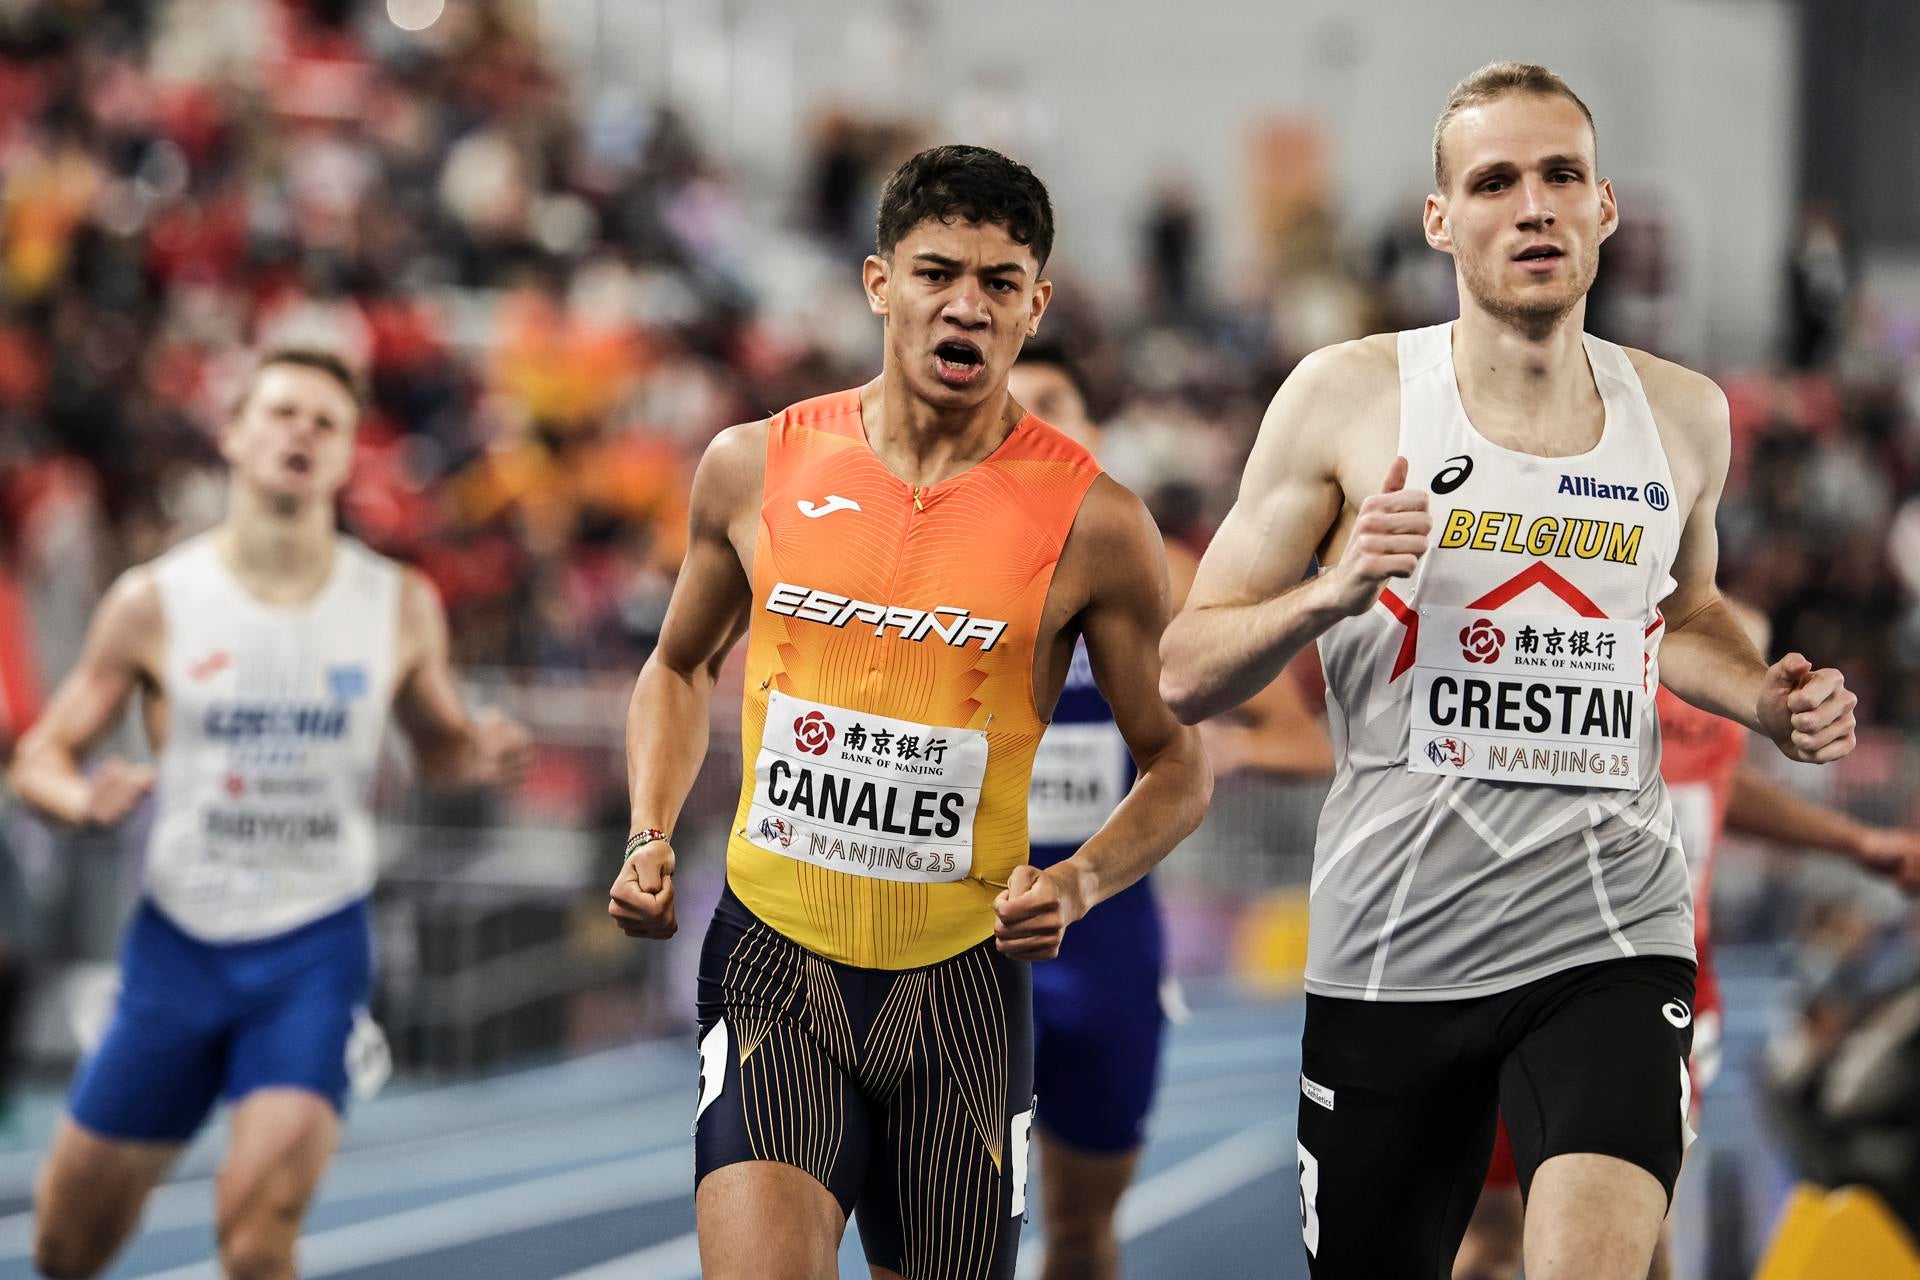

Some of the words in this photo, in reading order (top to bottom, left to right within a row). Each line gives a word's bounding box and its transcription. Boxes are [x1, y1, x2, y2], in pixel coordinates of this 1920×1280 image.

[1558, 474, 1639, 502] Allianz
[1438, 508, 1644, 566] BELGIUM
[765, 582, 1008, 651] ESPAÑA
[1514, 624, 1617, 660] 南京银行
[1514, 656, 1548, 668] BANK
[1551, 658, 1566, 668] OF
[1569, 660, 1616, 672] NANJING
[1429, 675, 1634, 740] CRESTAN
[841, 751, 872, 766] BANK
[876, 757, 891, 769] OF
[894, 763, 944, 776] NANJING
[843, 722, 949, 765] 南京银行
[1488, 745, 1606, 777] NANJING
[1608, 754, 1630, 777] 25
[768, 759, 965, 838] CANALES
[808, 832, 923, 871] NANJING
[926, 852, 956, 873] 25
